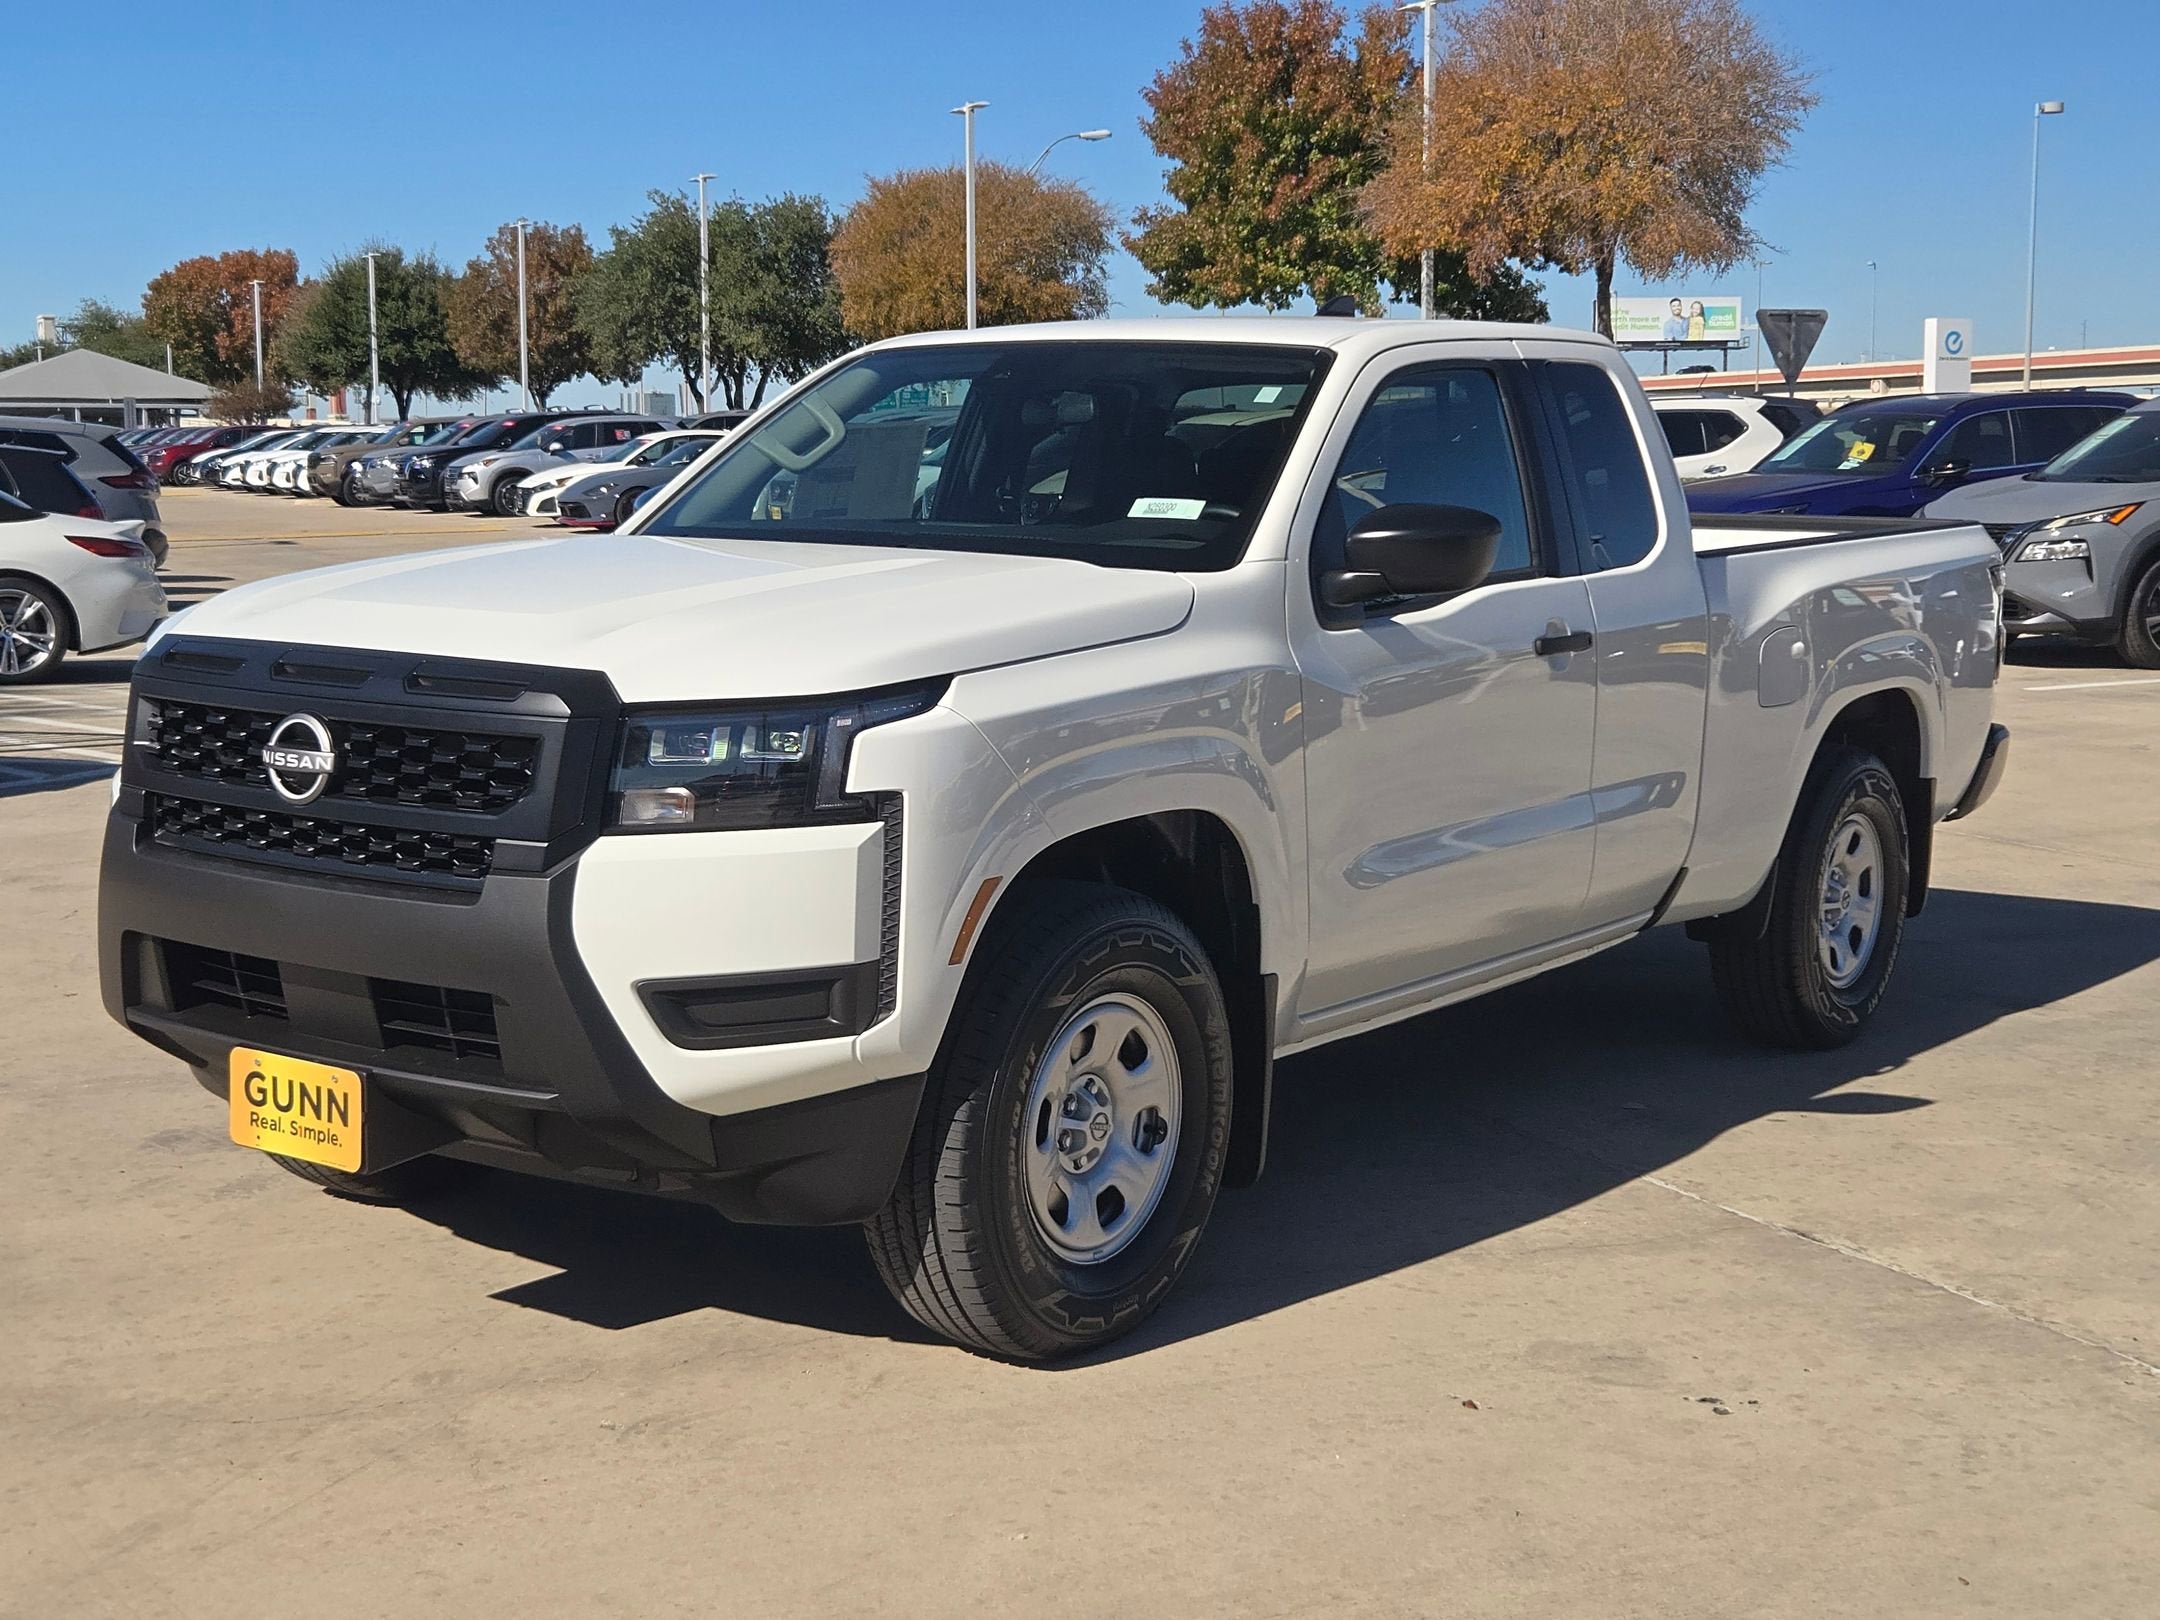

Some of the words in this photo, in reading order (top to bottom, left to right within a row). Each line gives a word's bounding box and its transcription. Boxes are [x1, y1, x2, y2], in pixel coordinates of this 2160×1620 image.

[262, 749, 332, 770] NISSAN
[244, 1070, 349, 1128] GUNN
[250, 1111, 285, 1134] Real.
